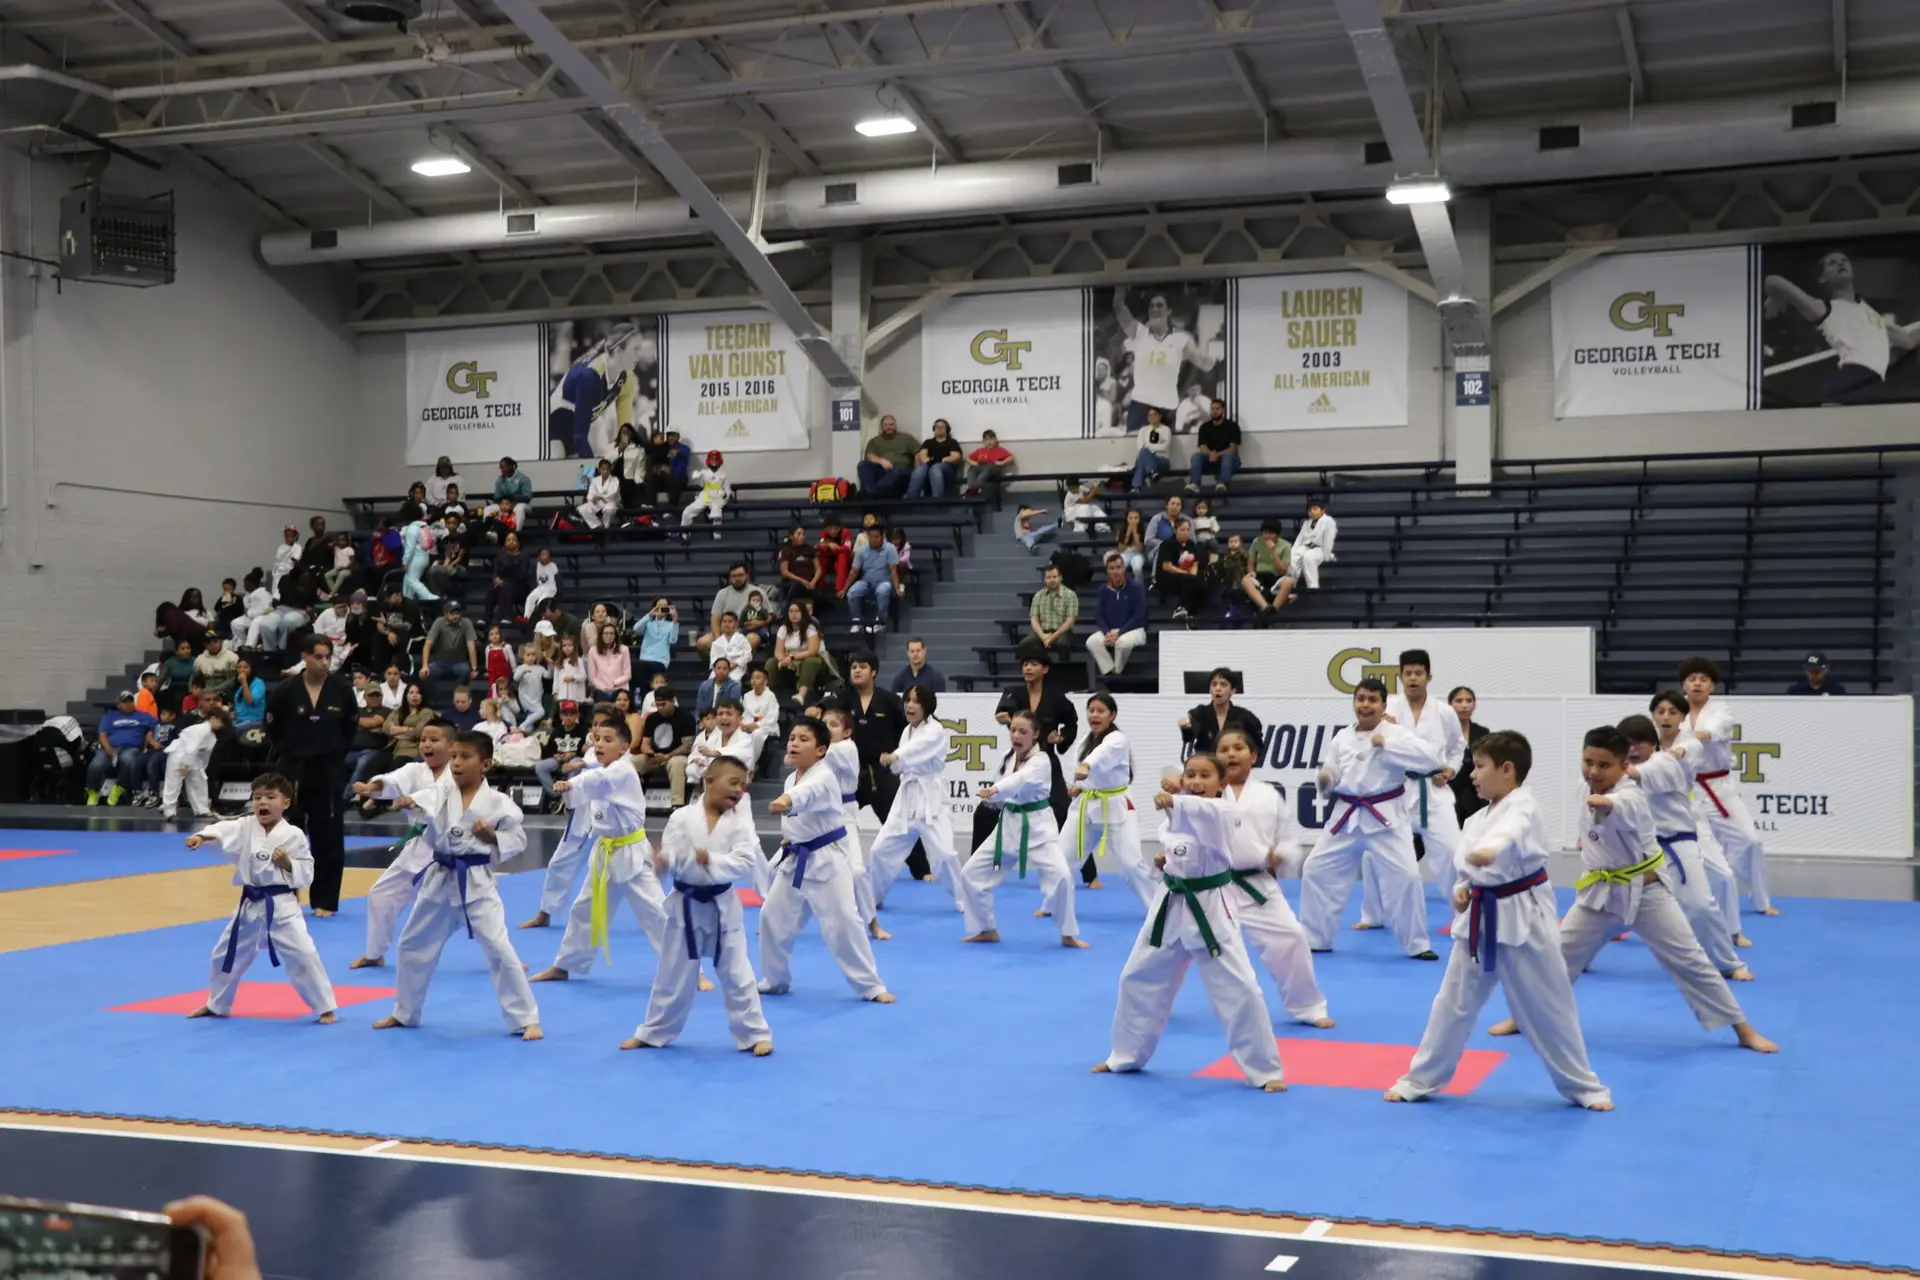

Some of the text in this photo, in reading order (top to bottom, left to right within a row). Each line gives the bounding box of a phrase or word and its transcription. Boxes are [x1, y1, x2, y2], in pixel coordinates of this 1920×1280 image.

[1281, 287, 1363, 319] LAUREN
[1609, 290, 1685, 337] GT
[704, 322, 771, 350] TEEGAN
[1287, 318, 1357, 349] SAUER
[970, 328, 1032, 370] GT
[1574, 342, 1721, 364] GEORGIA TECH
[688, 350, 786, 380] VAN GUNST
[1302, 351, 1341, 368] 2003
[1612, 364, 1682, 375] VOLLEYBALL
[446, 360, 497, 399] GT
[701, 382, 730, 397] 2015
[745, 380, 775, 395] 2016
[942, 376, 1061, 394] GEORGIA TECH
[1274, 370, 1370, 390] ALL-AMERICAN
[1463, 379, 1483, 396] 102
[698, 398, 778, 416] ALL-AMERICAN
[973, 396, 1028, 405] VOLLEYBALL
[422, 403, 522, 421] GEORGIA TECH
[839, 407, 854, 421] 101
[448, 422, 495, 431] VOLLEYBALL
[1756, 794, 1828, 815] TECH
